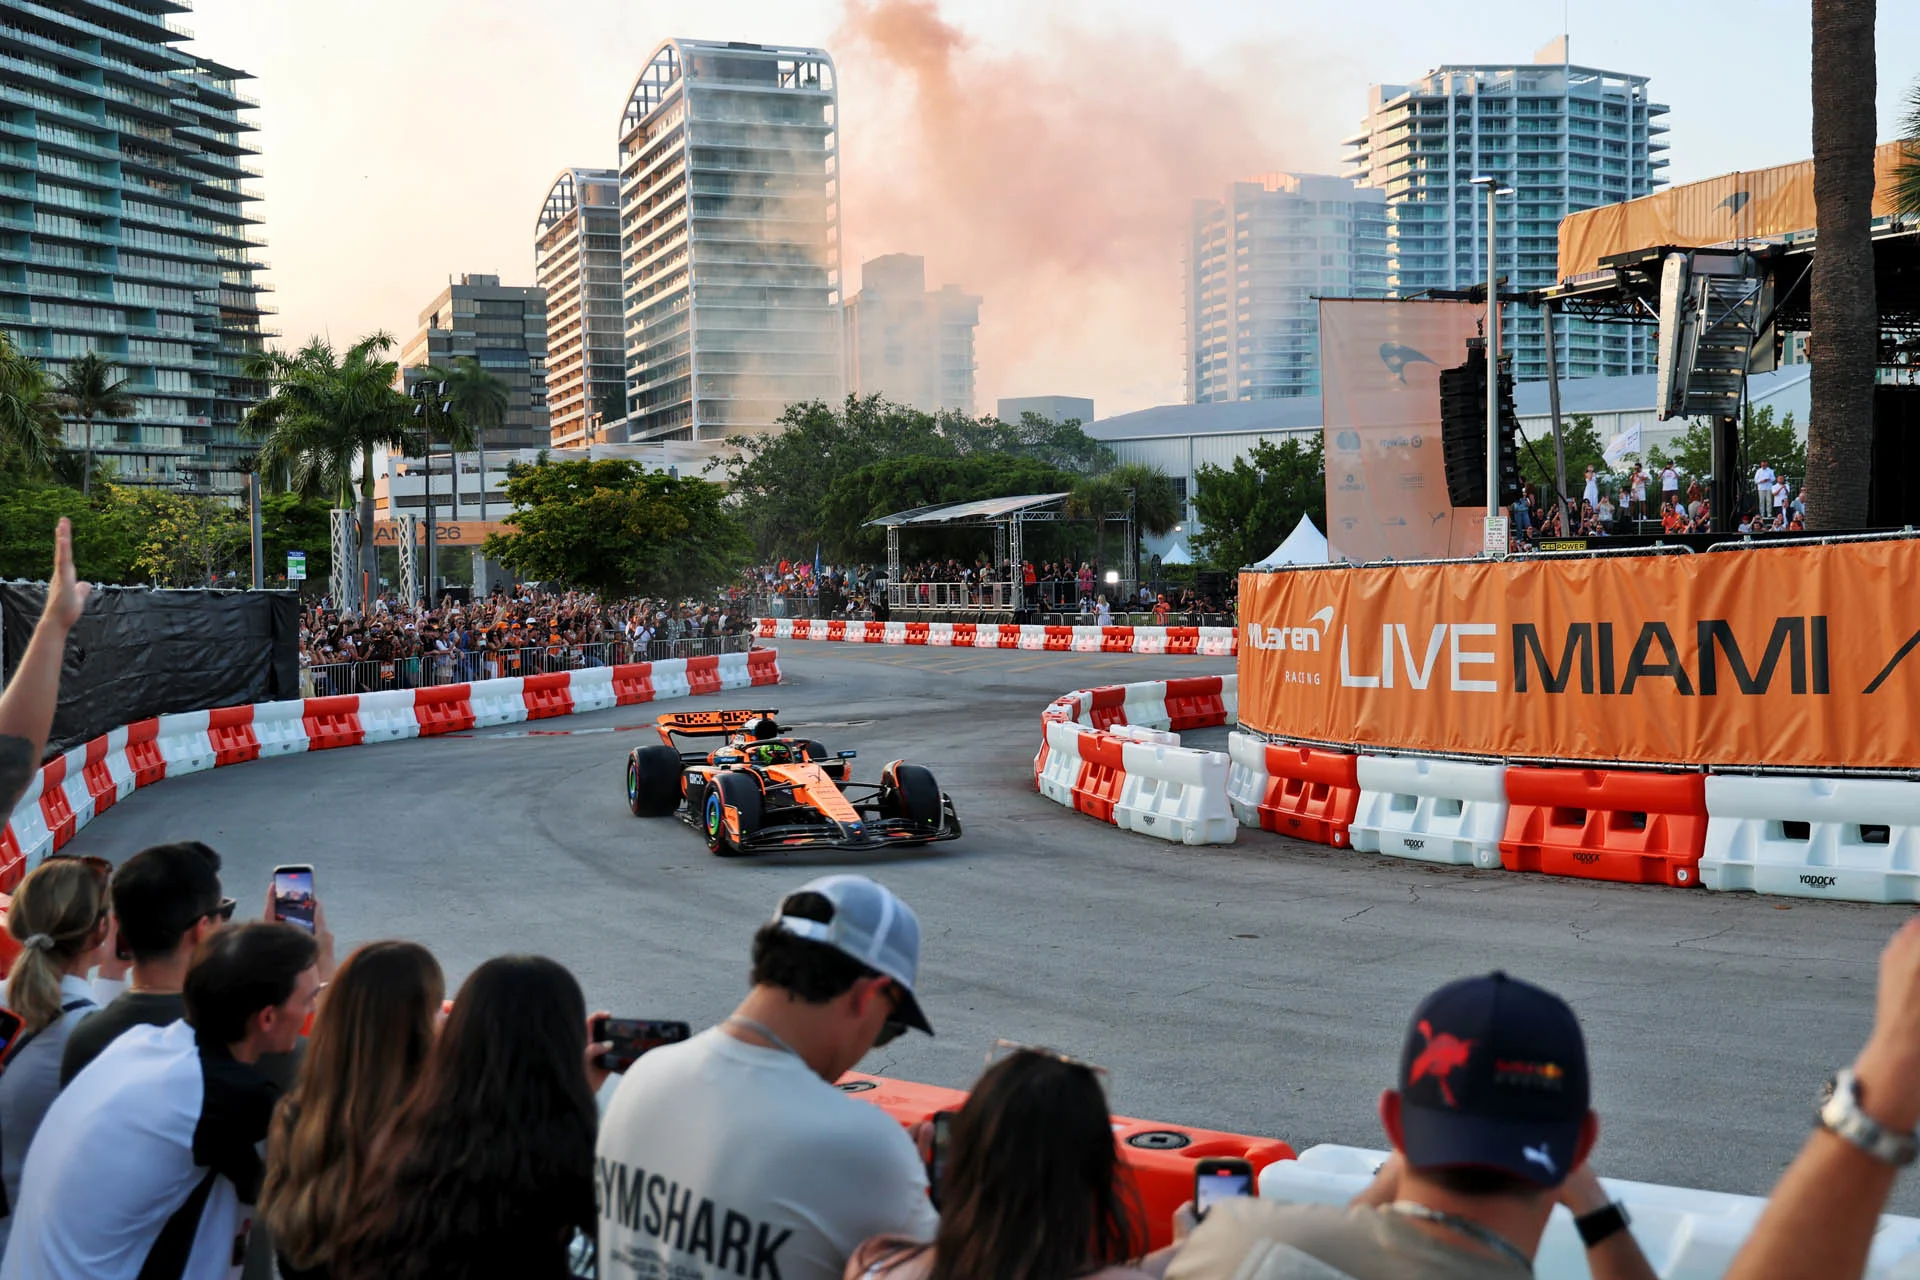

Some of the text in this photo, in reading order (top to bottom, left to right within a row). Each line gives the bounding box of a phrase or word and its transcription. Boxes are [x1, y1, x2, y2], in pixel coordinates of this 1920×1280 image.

[435, 526, 461, 540] 26
[1340, 623, 1497, 692] LIVE
[1512, 615, 1830, 696] MIAMI
[1285, 670, 1320, 685] RACING
[1799, 874, 1836, 886] YODOCK
